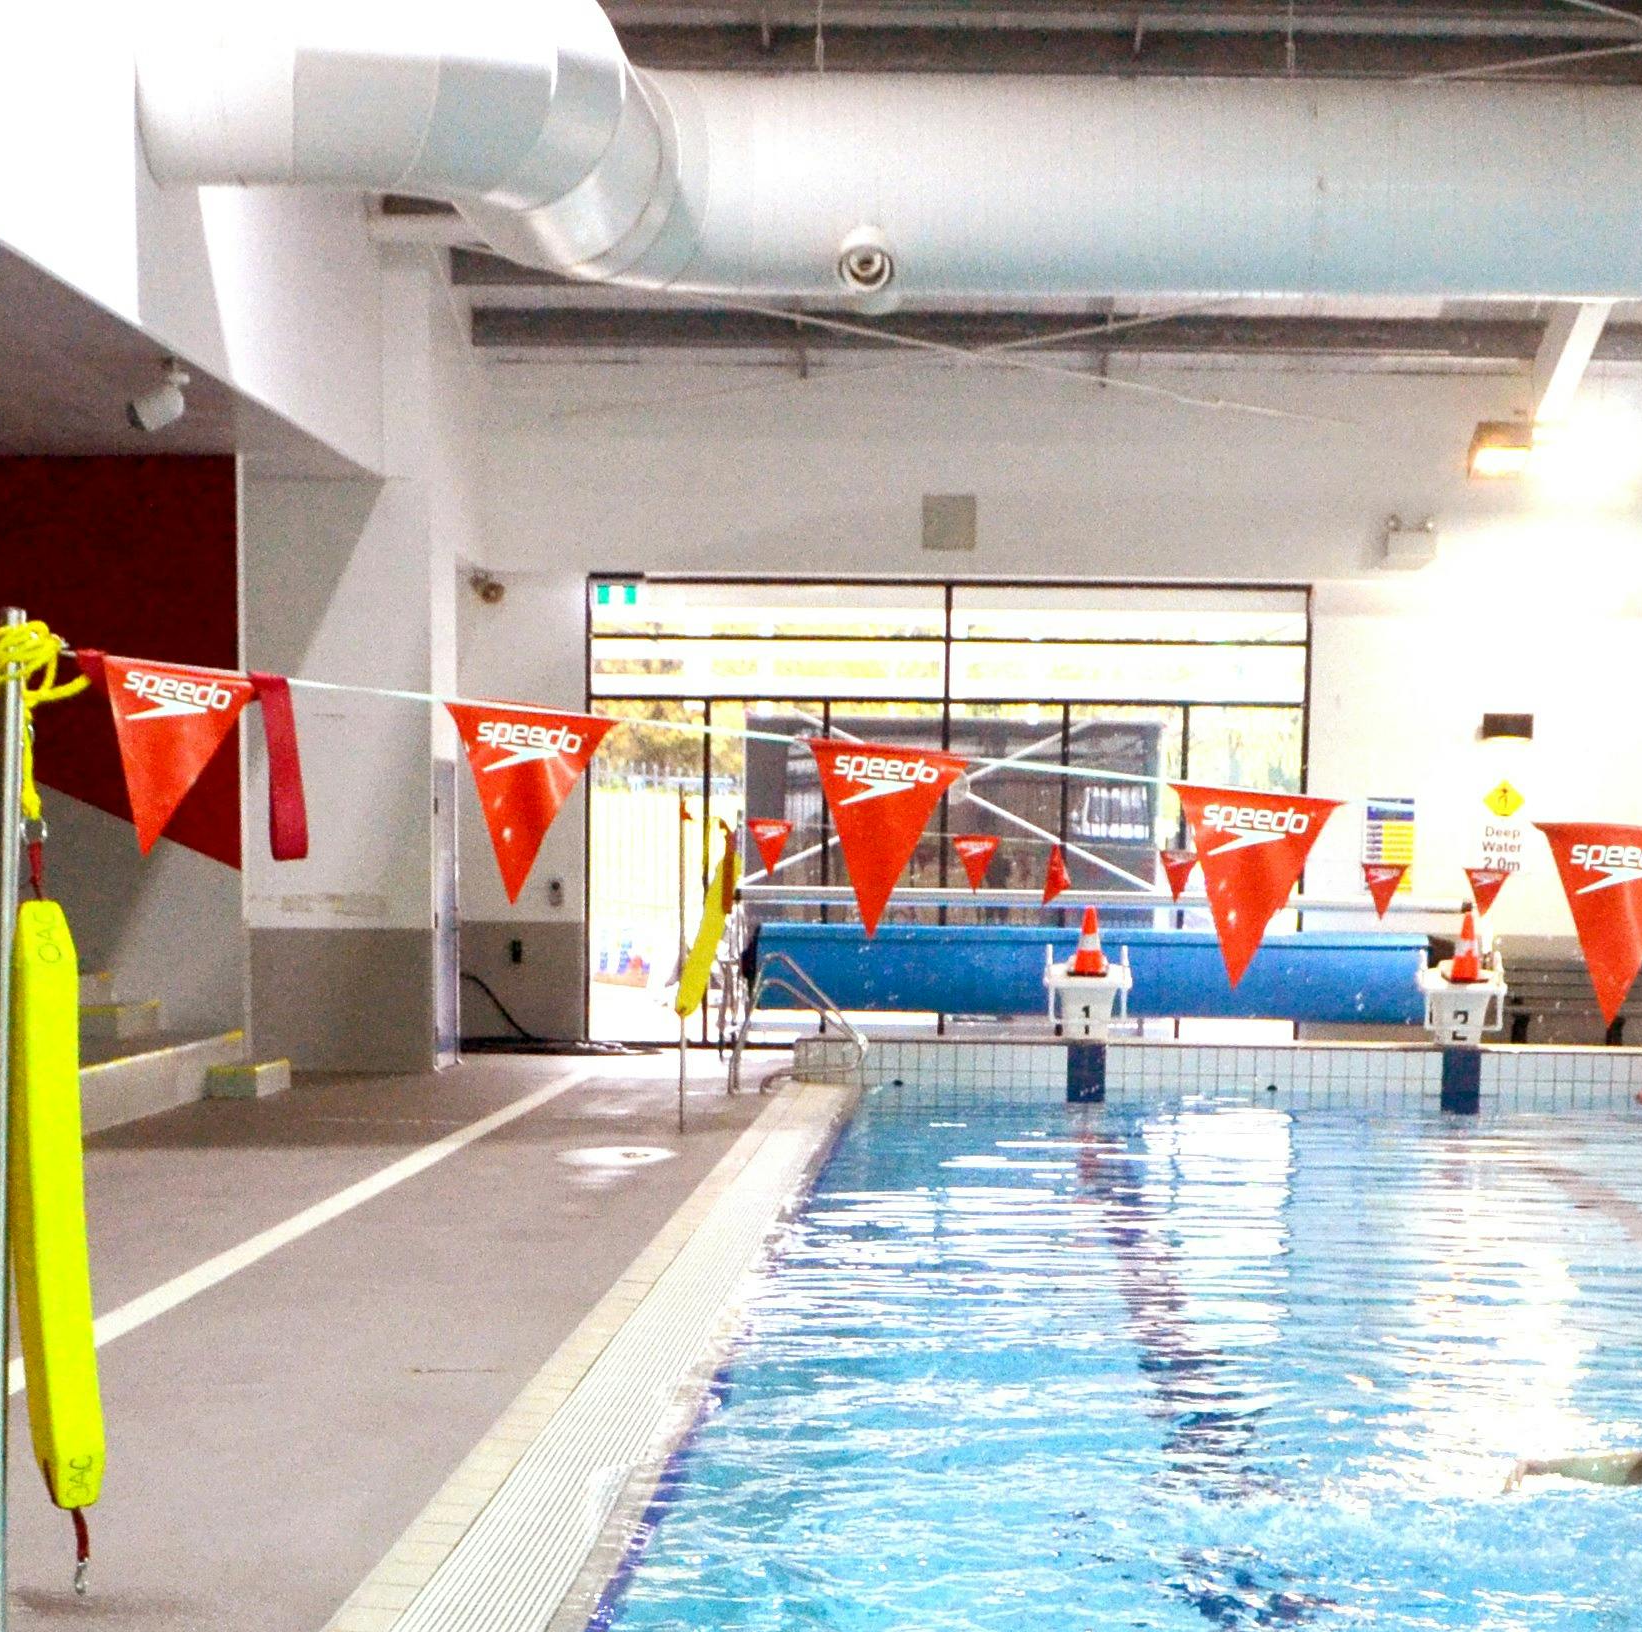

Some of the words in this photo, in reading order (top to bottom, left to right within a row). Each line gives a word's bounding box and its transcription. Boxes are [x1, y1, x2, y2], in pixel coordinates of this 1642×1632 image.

[123, 671, 232, 710] speedo
[477, 721, 582, 754] speedo
[834, 755, 938, 784] speedo
[1202, 803, 1309, 834] speedo
[1484, 825, 1521, 840] Deep
[1482, 841, 1521, 853] Water
[1483, 856, 1520, 871] 20m
[1082, 1005, 1091, 1035] 1
[1452, 1010, 1469, 1041] 2
